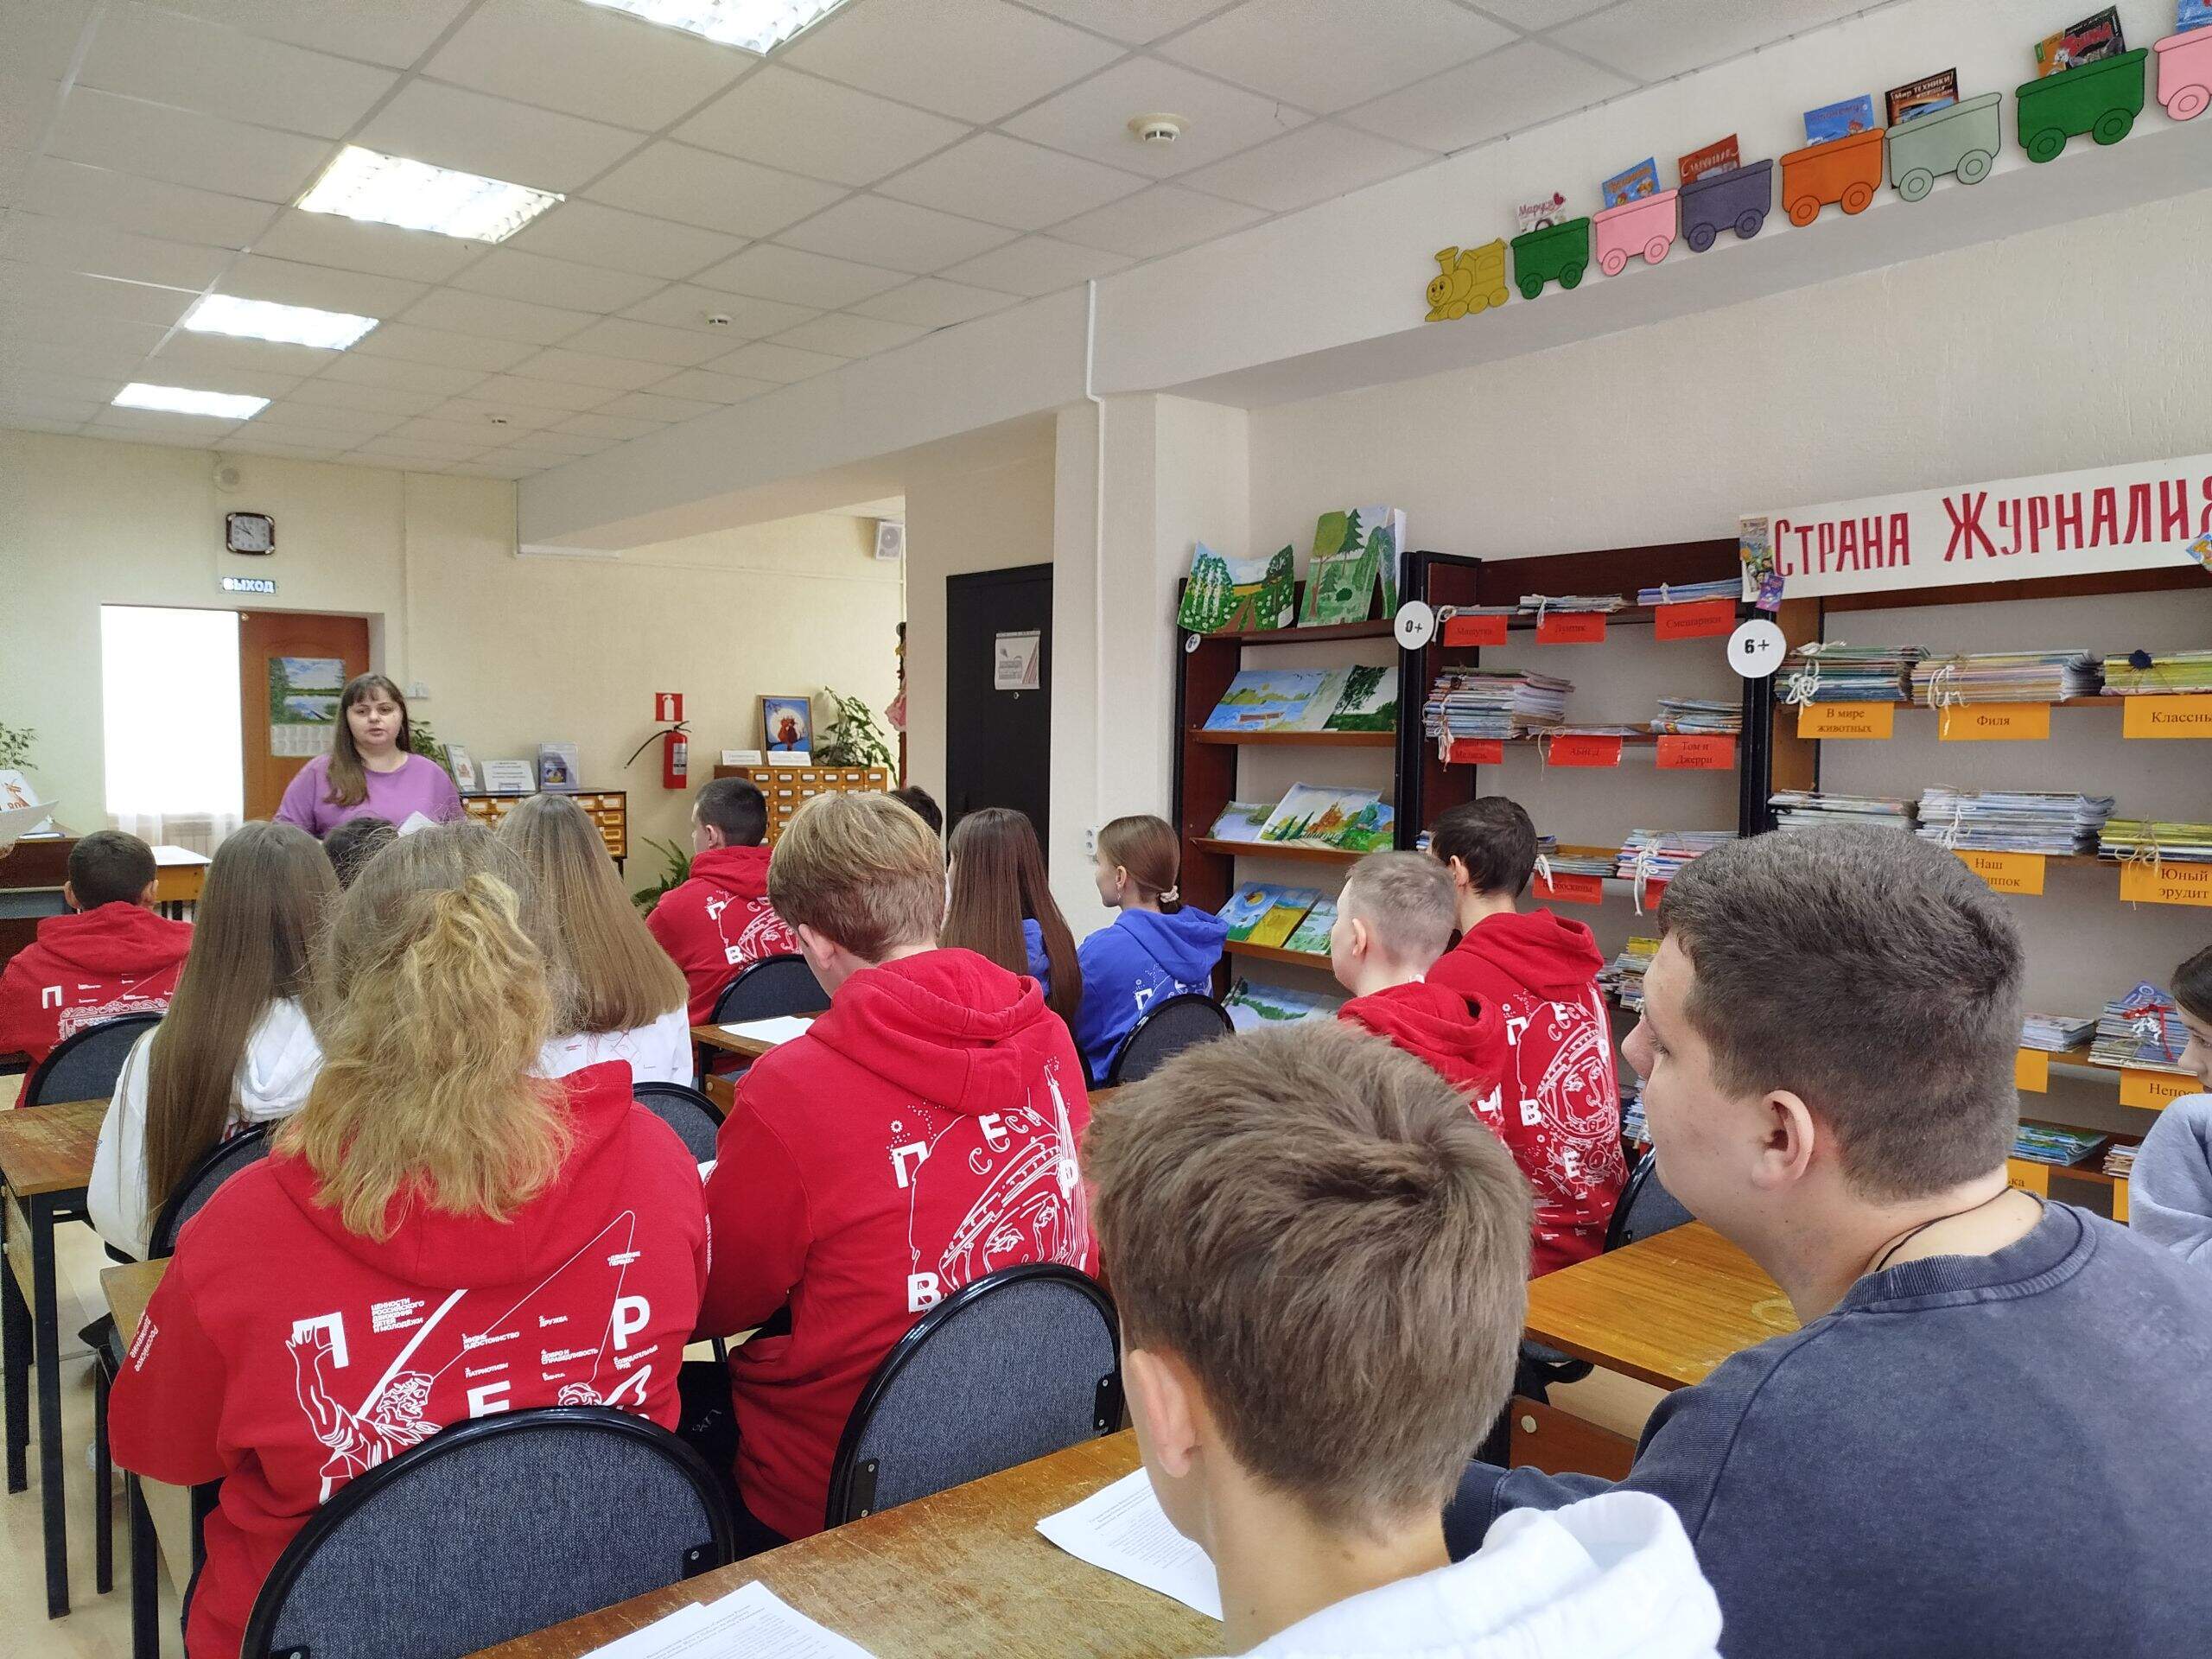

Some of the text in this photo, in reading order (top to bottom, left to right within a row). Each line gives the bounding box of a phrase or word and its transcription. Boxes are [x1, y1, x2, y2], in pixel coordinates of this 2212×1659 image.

[1775, 512, 1910, 577] СТРАНА
[223, 577, 275, 594] ВЫХОД
[1405, 619, 1423, 633] 0+
[1666, 615, 1721, 629] Смешарики
[1744, 638, 1770, 655] 6+
[1827, 708, 1866, 720] В мире
[1976, 715, 2011, 727] Филя
[1817, 723, 1872, 734] животных
[1681, 741, 1709, 751] Том и
[1675, 754, 1713, 768] Джерри
[1975, 858, 2003, 870] Наш
[2161, 868, 2209, 881] Юный
[2158, 887, 2209, 900] эрудит
[134, 1324, 159, 1372] Российское
[465, 1363, 509, 1379] ПАТРИОТИЗМ
